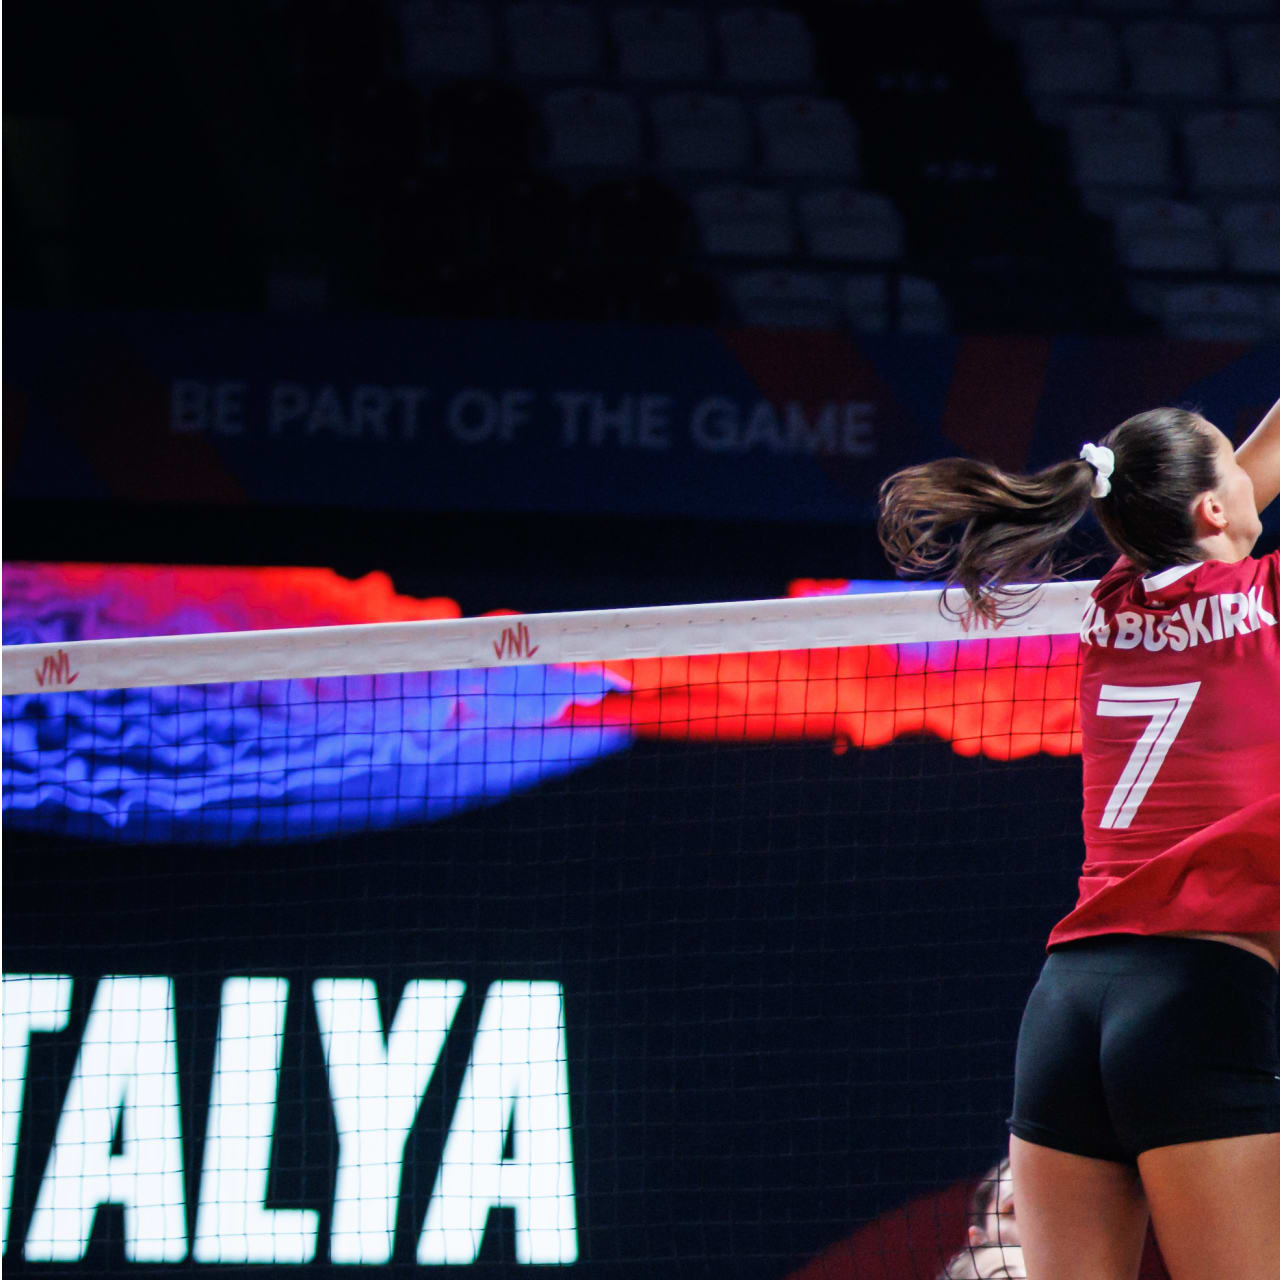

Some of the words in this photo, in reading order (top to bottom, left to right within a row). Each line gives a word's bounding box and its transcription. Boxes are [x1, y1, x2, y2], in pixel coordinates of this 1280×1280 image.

[169, 377, 247, 434] BE
[267, 382, 430, 440] PART
[448, 387, 537, 443] OF
[553, 391, 672, 450] THE
[690, 396, 879, 458] GAME
[492, 622, 539, 660] VNL
[1113, 585, 1278, 652] BUSKIRK
[35, 649, 79, 686] VNL
[1096, 681, 1202, 829] 7
